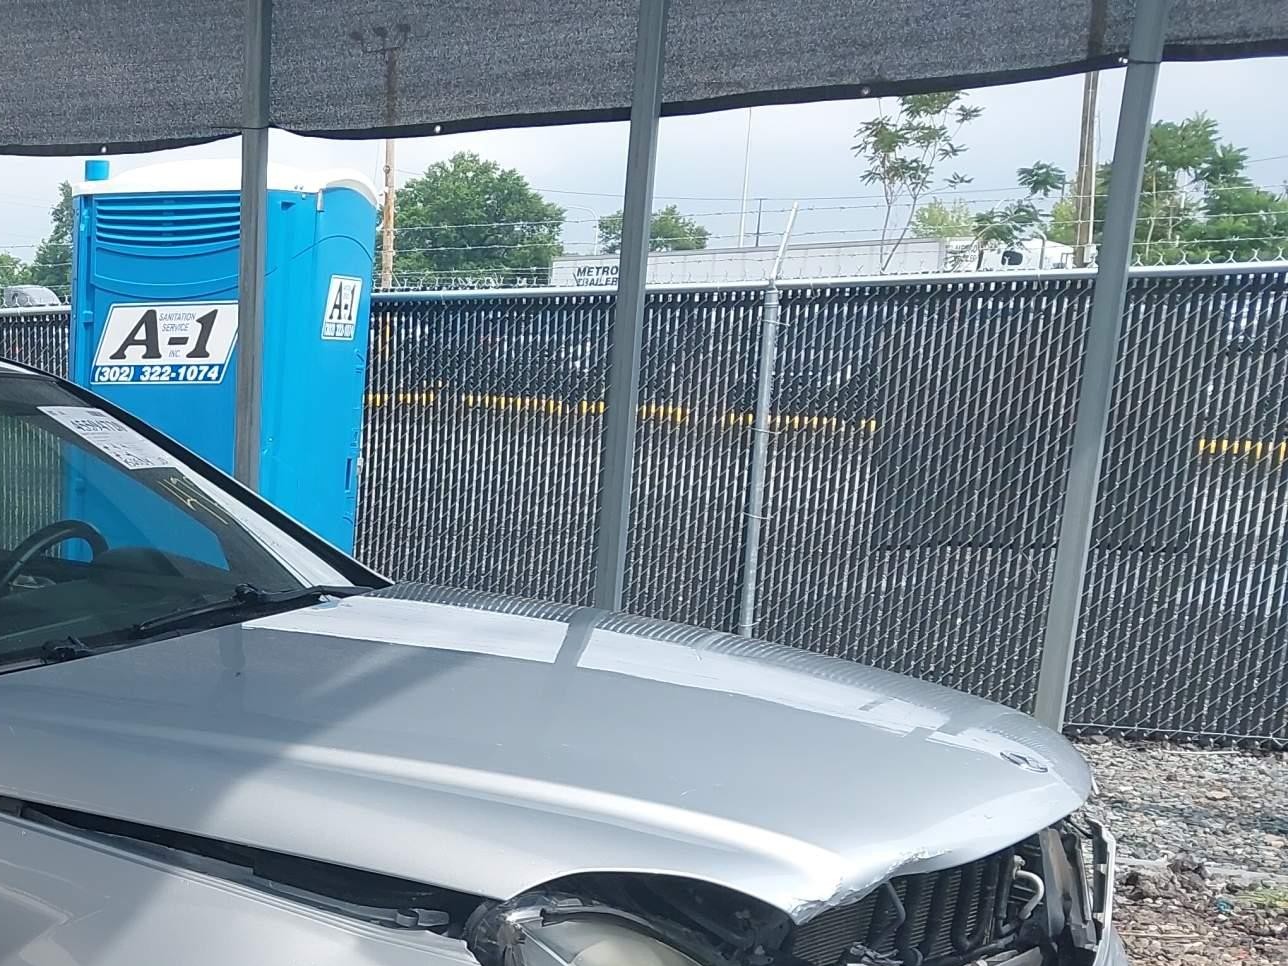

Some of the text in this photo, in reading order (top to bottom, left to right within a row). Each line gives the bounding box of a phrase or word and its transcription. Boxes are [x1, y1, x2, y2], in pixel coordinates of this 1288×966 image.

[576, 265, 619, 277] METRO
[328, 280, 357, 321] A-1
[158, 312, 197, 321] SANITATION
[109, 308, 219, 360] A-1
[161, 323, 190, 332] SERVICE
[94, 365, 220, 382] (302) 322-1074
